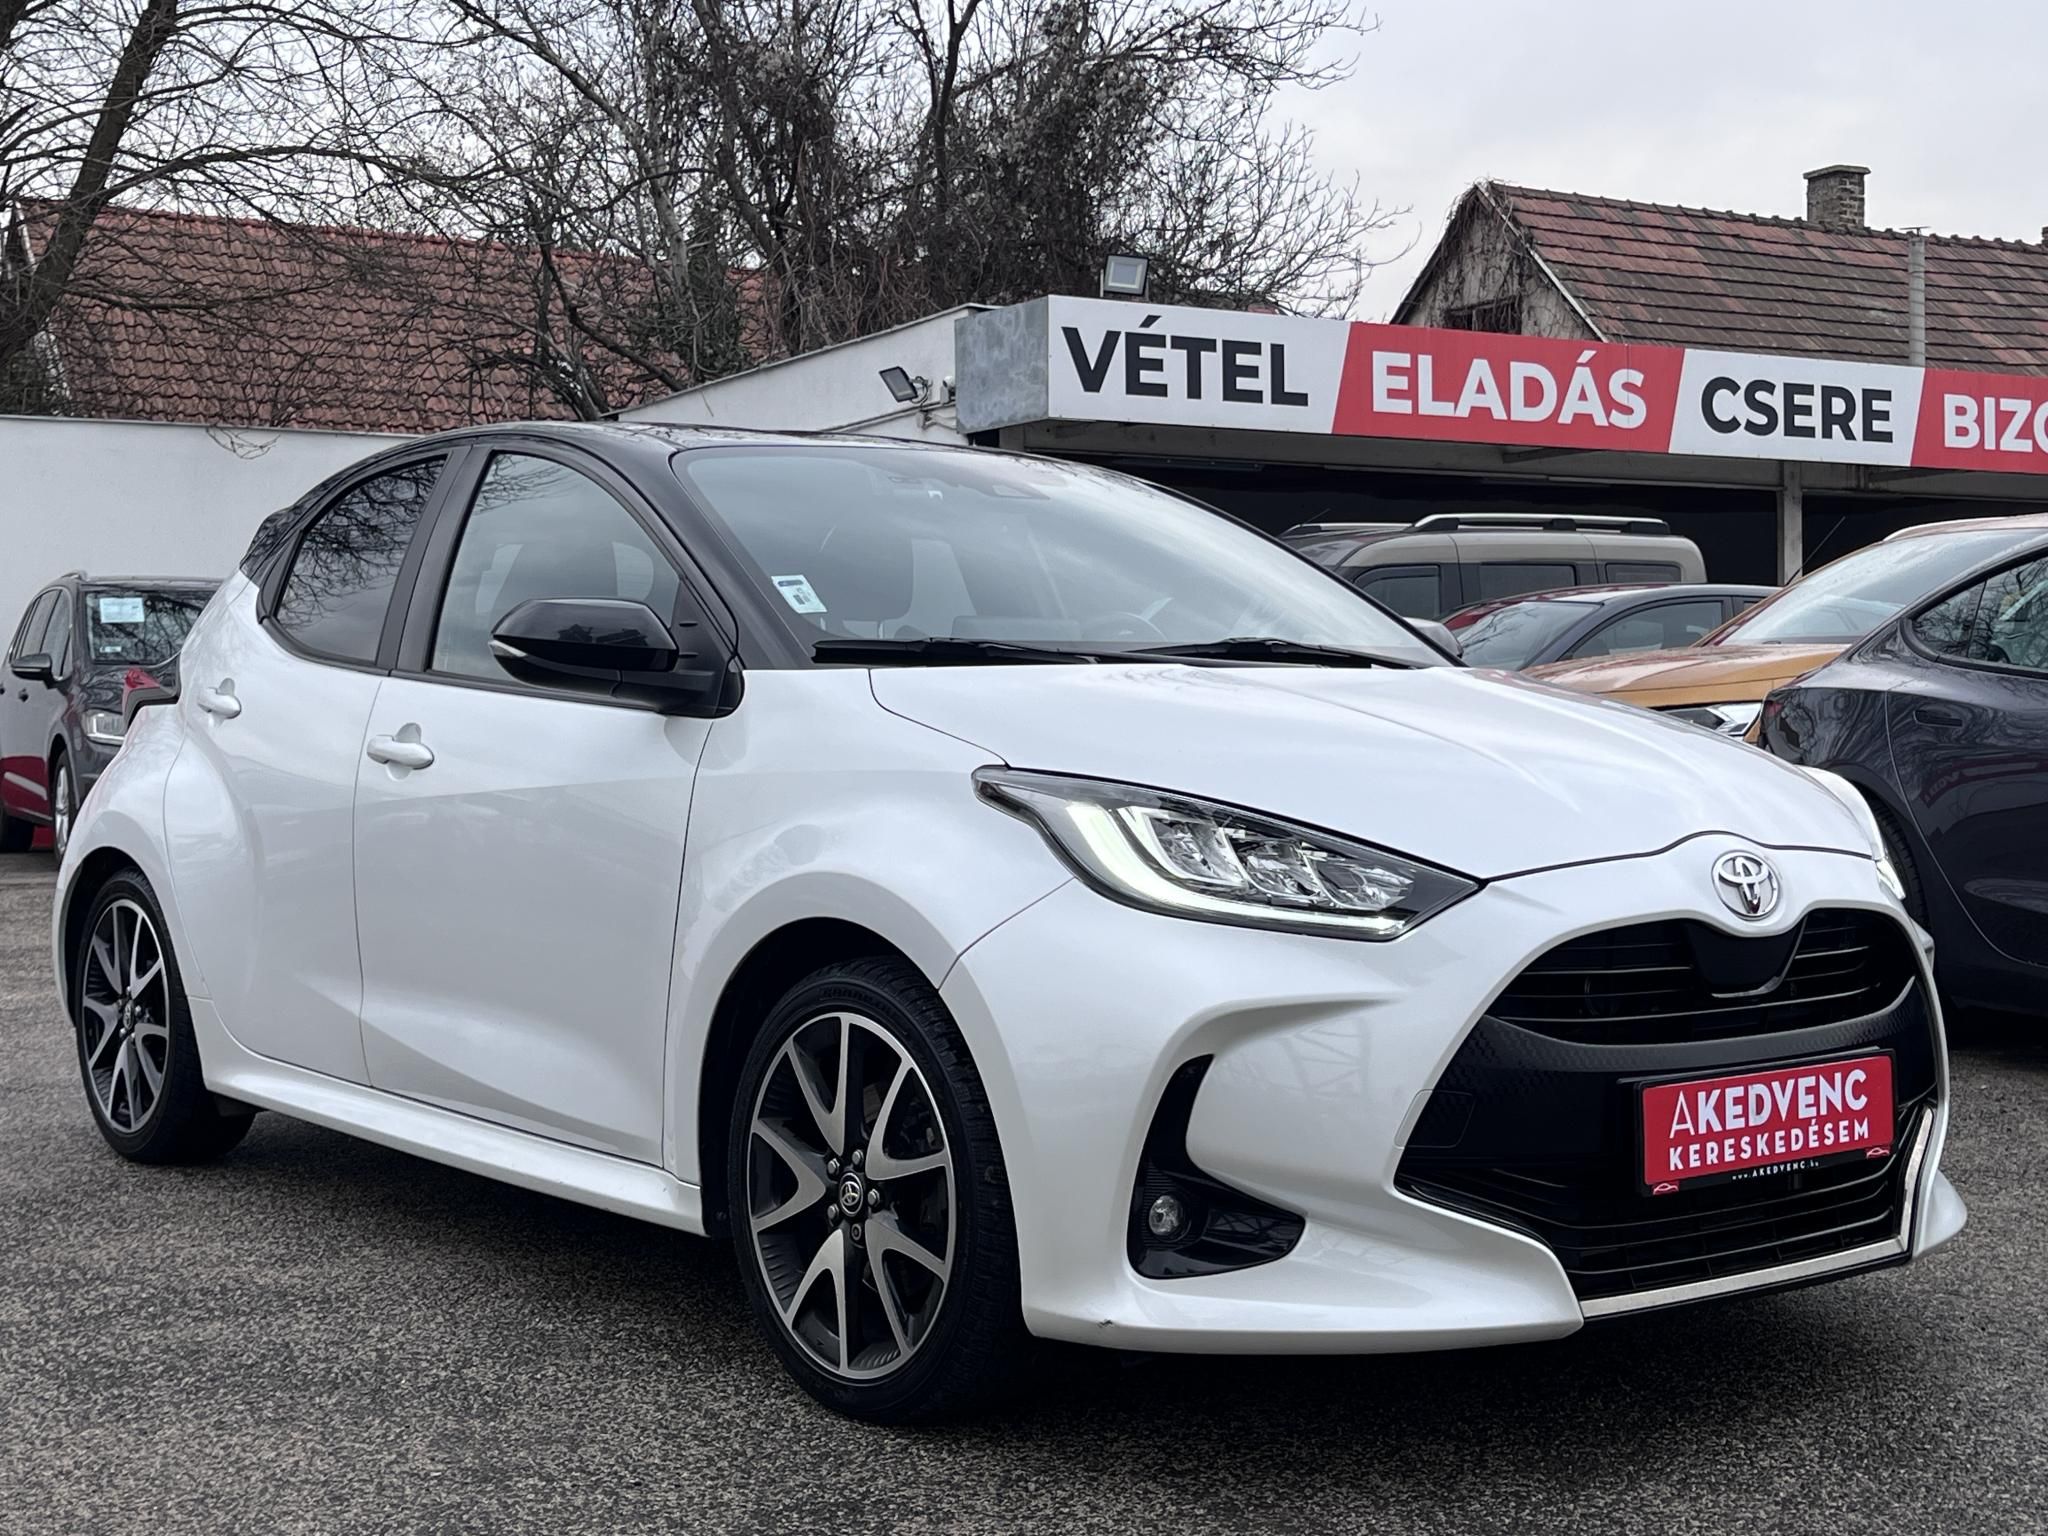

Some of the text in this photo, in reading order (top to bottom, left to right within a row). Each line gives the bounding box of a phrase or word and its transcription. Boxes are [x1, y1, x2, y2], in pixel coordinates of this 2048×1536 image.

[1061, 314, 1309, 407] VÉTEL
[1372, 350, 1647, 429] ELADÁS
[1701, 376, 1894, 443] CSERE
[1669, 1068, 1868, 1139] AKEDVENC
[1669, 1117, 1869, 1171] KERESKEDÉSEM
